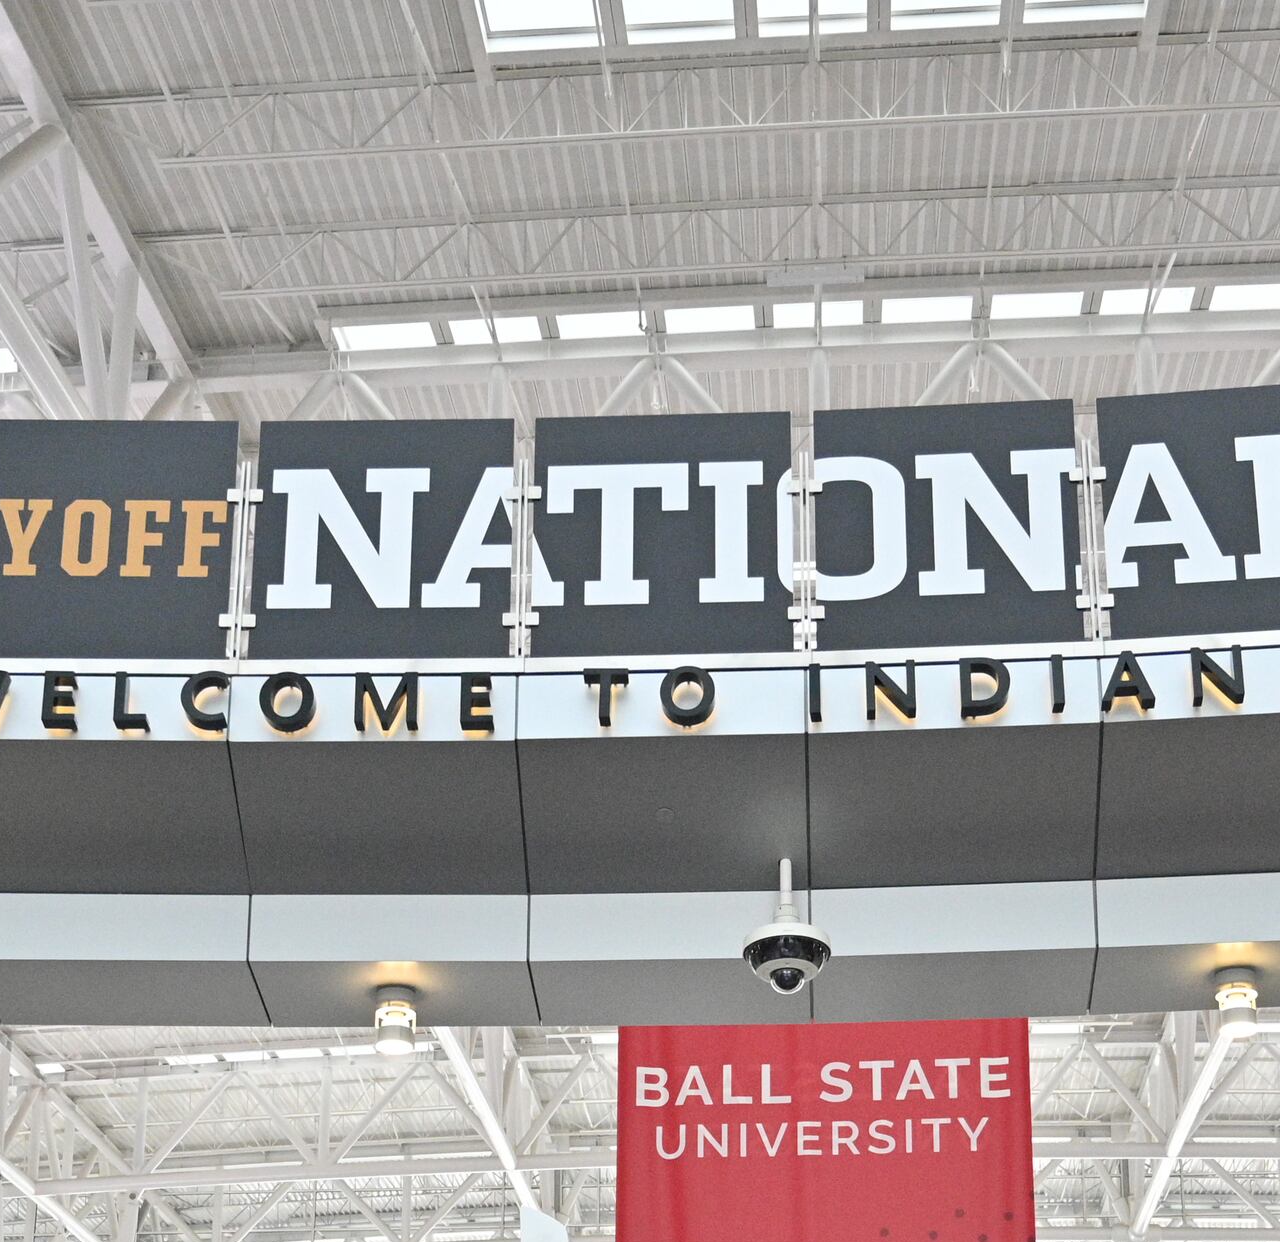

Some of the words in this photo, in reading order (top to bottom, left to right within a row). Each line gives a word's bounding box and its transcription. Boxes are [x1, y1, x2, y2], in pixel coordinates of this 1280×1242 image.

[583, 665, 716, 728] TO
[635, 1063, 792, 1108] BALL
[819, 1056, 1011, 1103] STATE
[654, 1116, 990, 1160] UNIVERSITY
